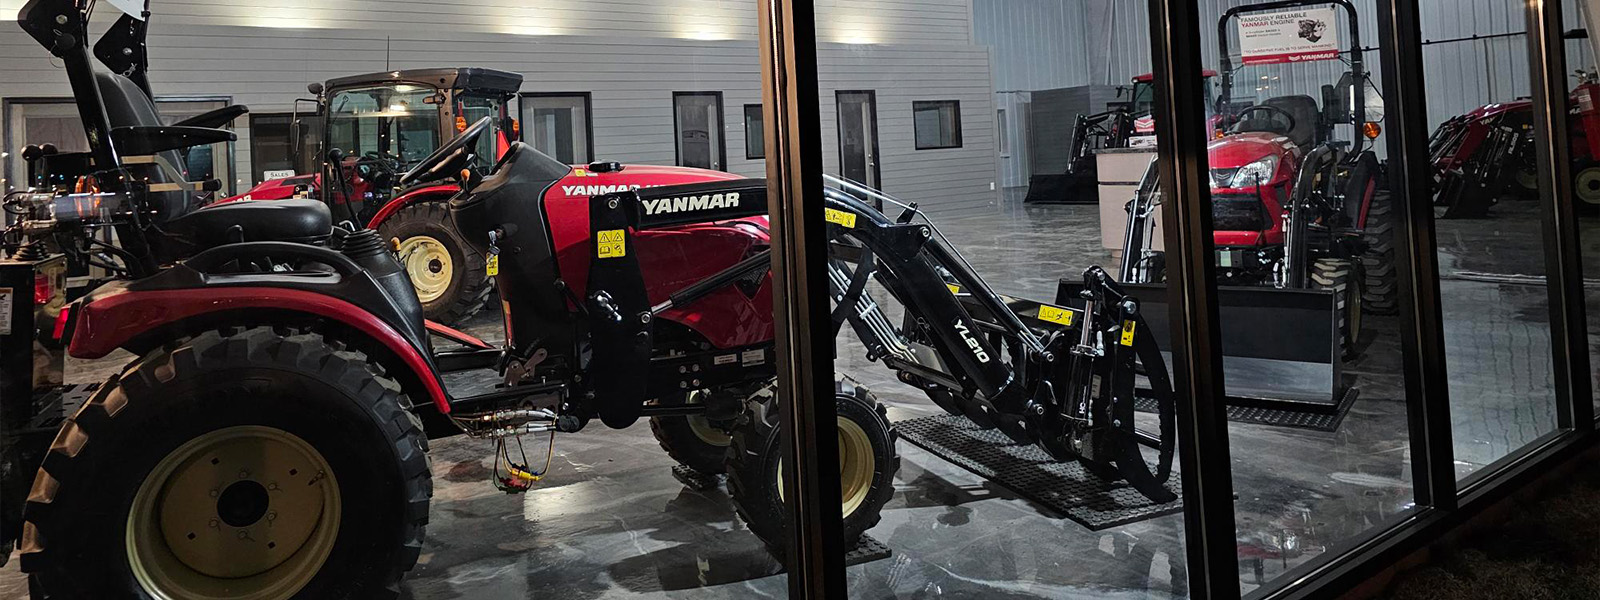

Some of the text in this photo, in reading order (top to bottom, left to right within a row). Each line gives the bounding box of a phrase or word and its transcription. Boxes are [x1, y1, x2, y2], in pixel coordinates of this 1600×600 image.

[1275, 12, 1307, 20] RELIABLE
[642, 192, 740, 215] YANMAR
[954, 319, 990, 363] YL210
